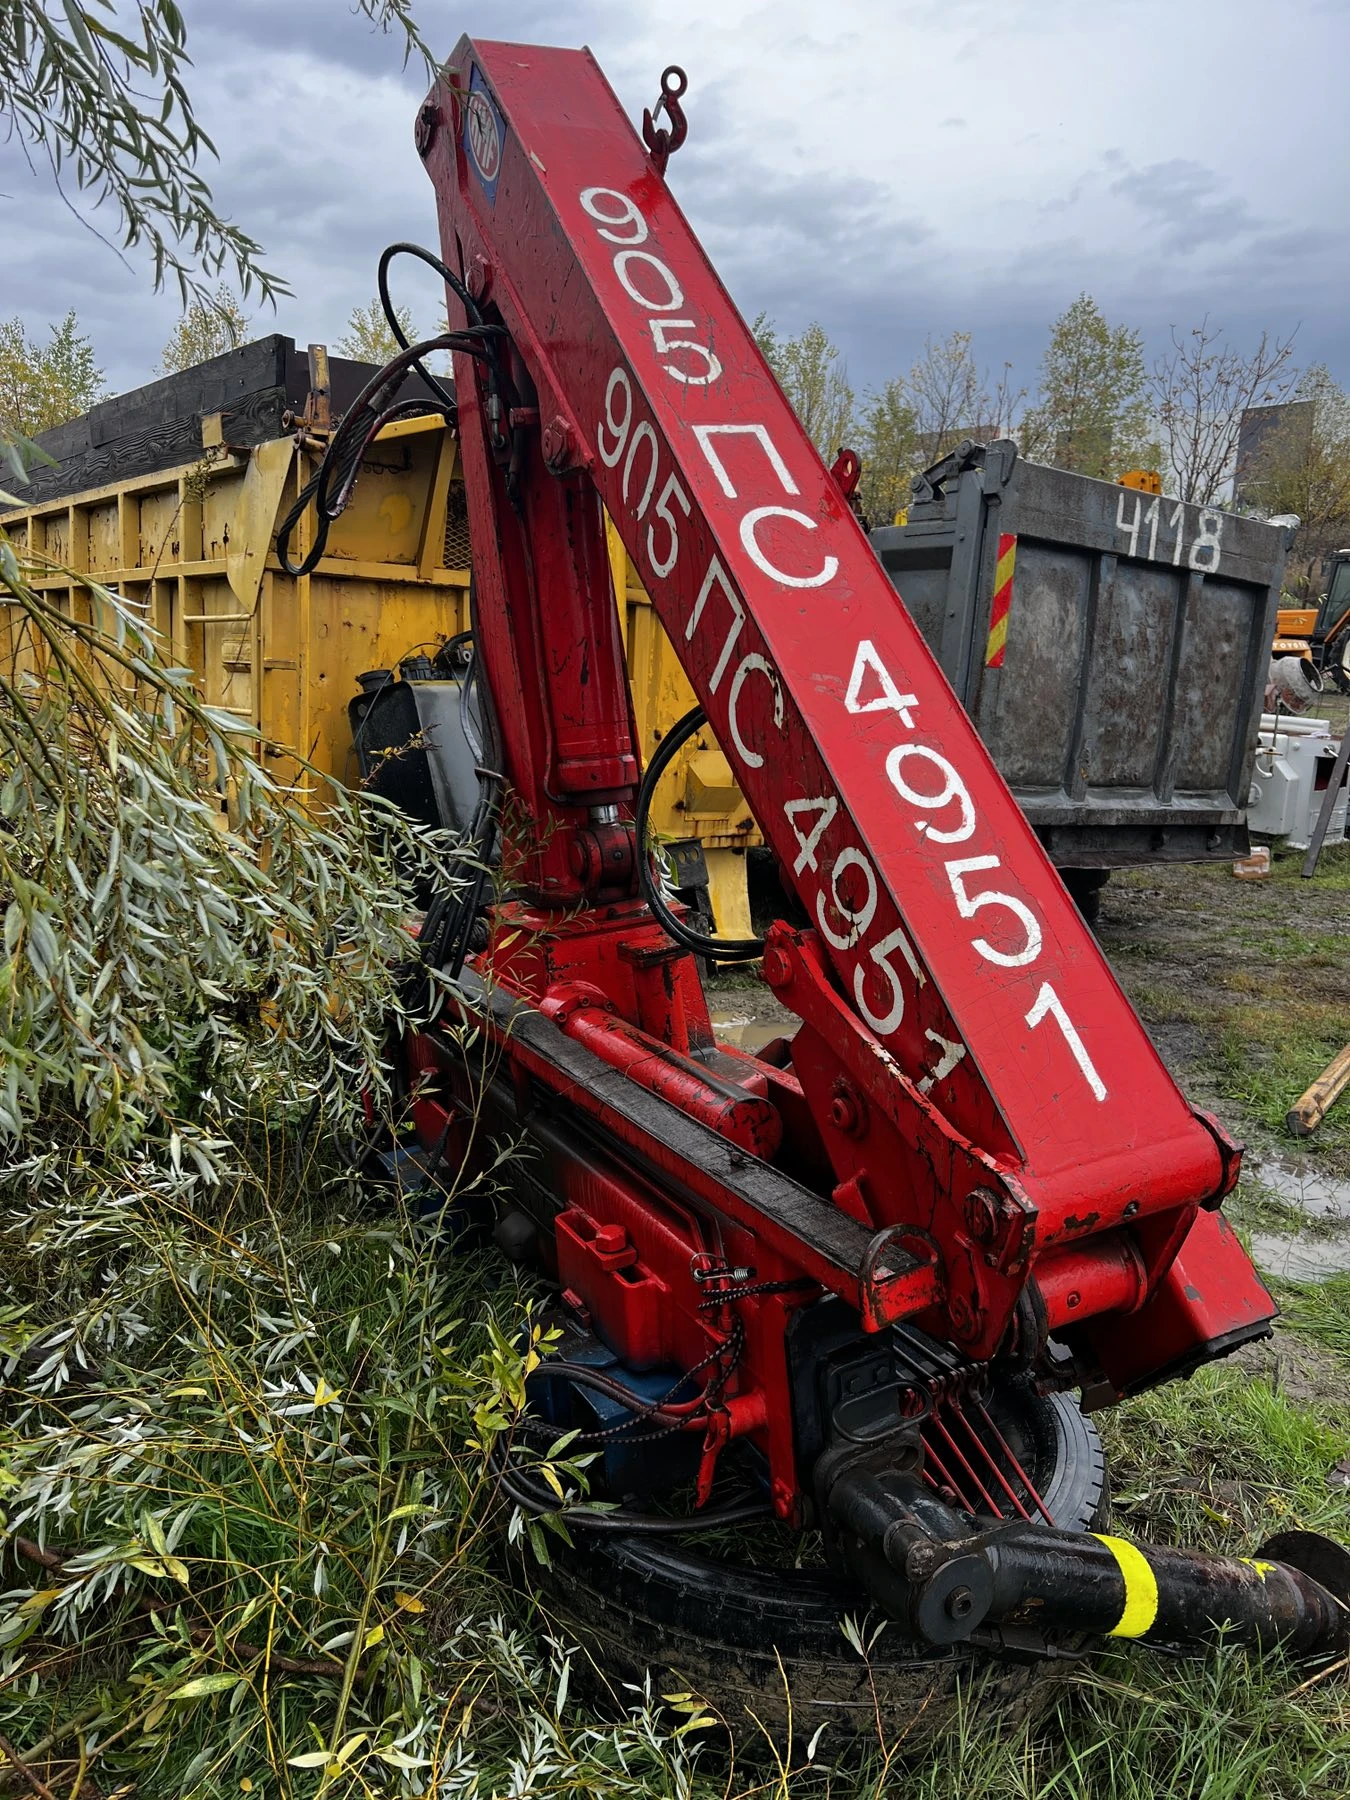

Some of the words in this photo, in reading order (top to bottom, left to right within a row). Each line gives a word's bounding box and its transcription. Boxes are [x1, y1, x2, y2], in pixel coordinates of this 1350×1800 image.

[580, 187, 723, 385] 905
[692, 424, 839, 588] ПС
[844, 639, 1107, 1102] 4951
[598, 367, 691, 578] 905
[685, 553, 784, 768] ПС
[1116, 493, 1223, 573] 4118
